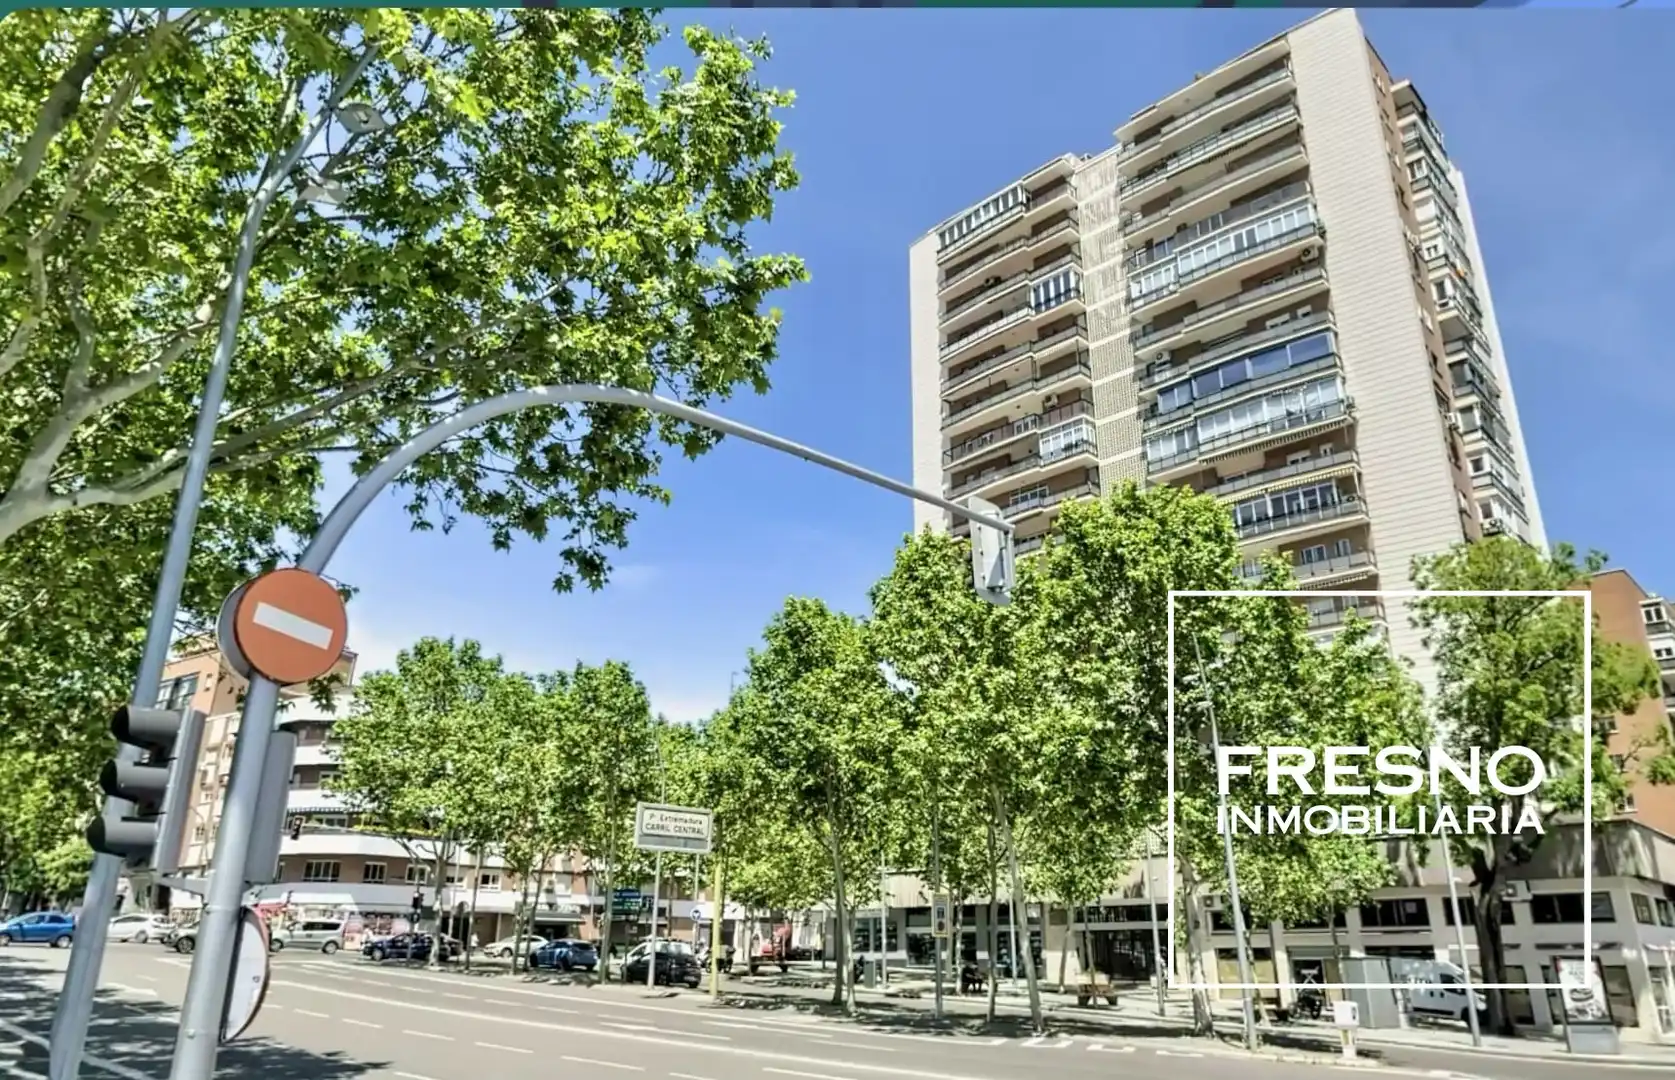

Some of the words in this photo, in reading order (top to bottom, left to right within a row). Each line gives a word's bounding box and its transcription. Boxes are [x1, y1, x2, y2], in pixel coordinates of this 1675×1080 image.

[659, 813, 703, 824] Extremadura
[645, 822, 671, 832] CARRIL
[673, 824, 704, 835] CENTRAL
